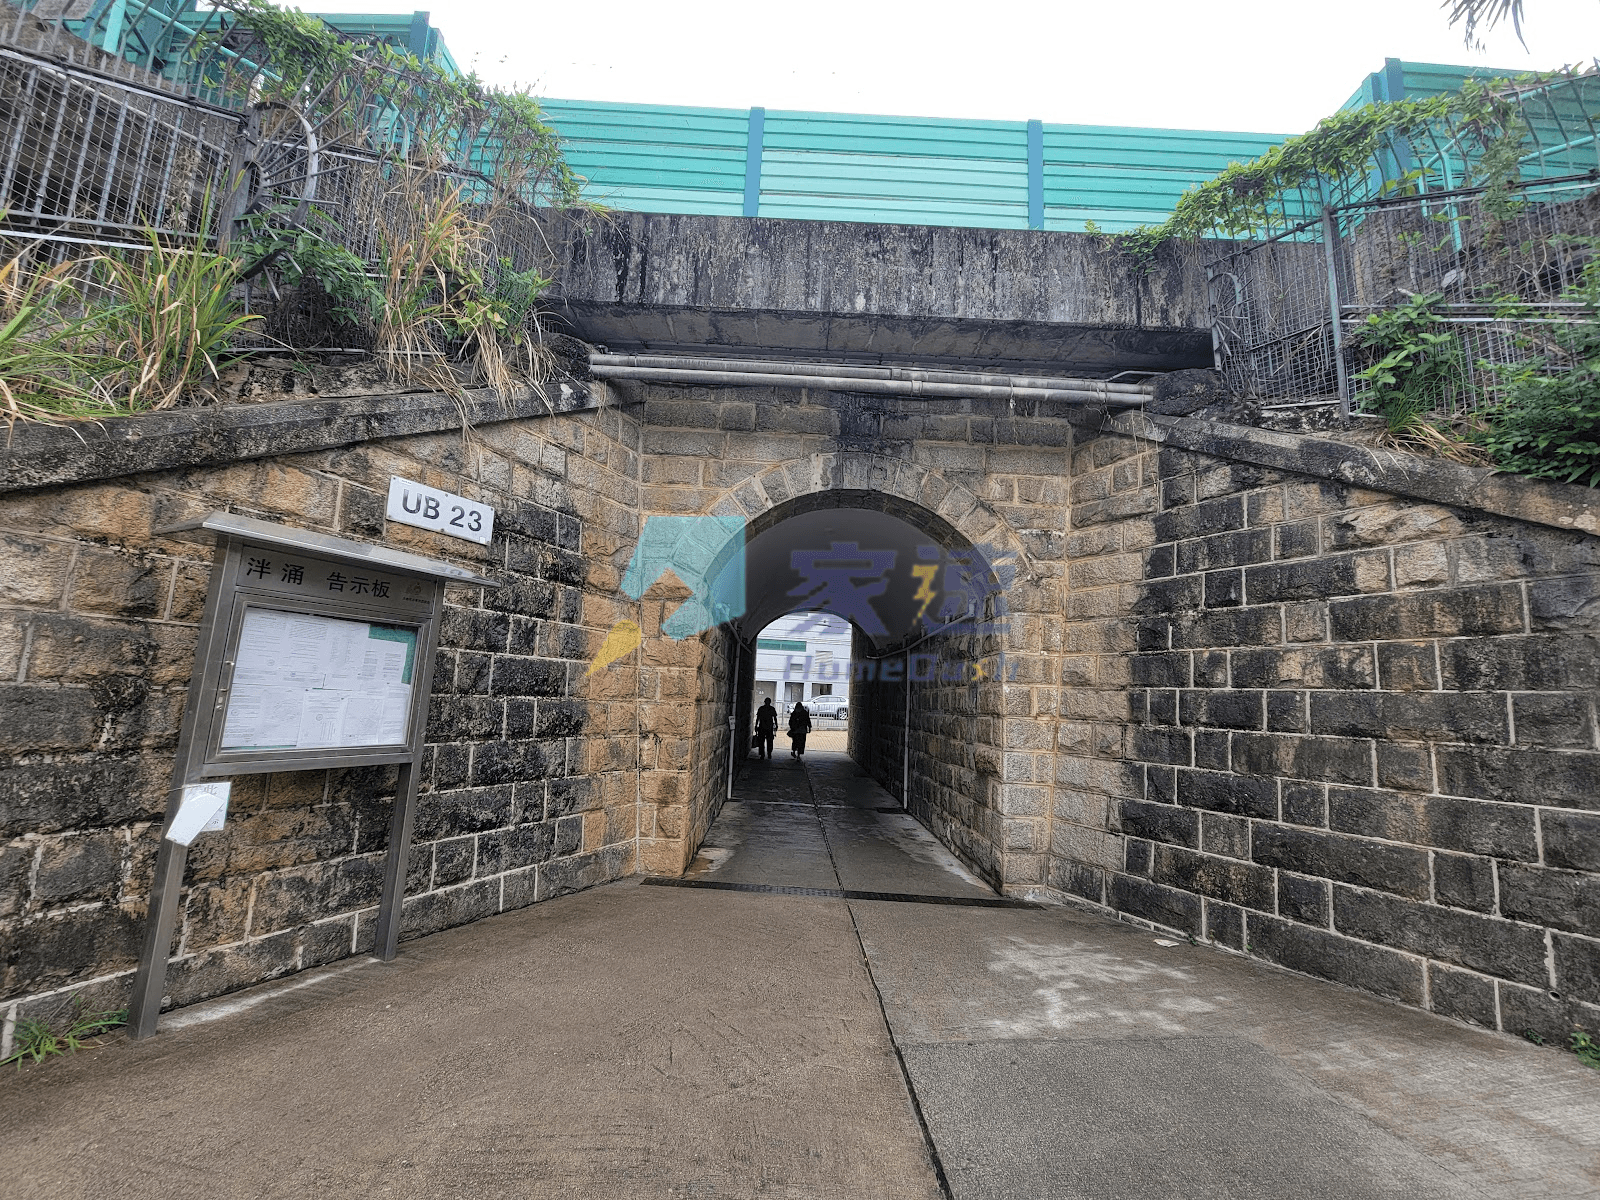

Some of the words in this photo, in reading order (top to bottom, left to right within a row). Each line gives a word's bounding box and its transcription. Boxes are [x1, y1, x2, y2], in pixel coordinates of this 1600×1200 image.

[402, 489, 440, 520] UB
[449, 505, 482, 532] 23
[326, 571, 391, 599] 告示板
